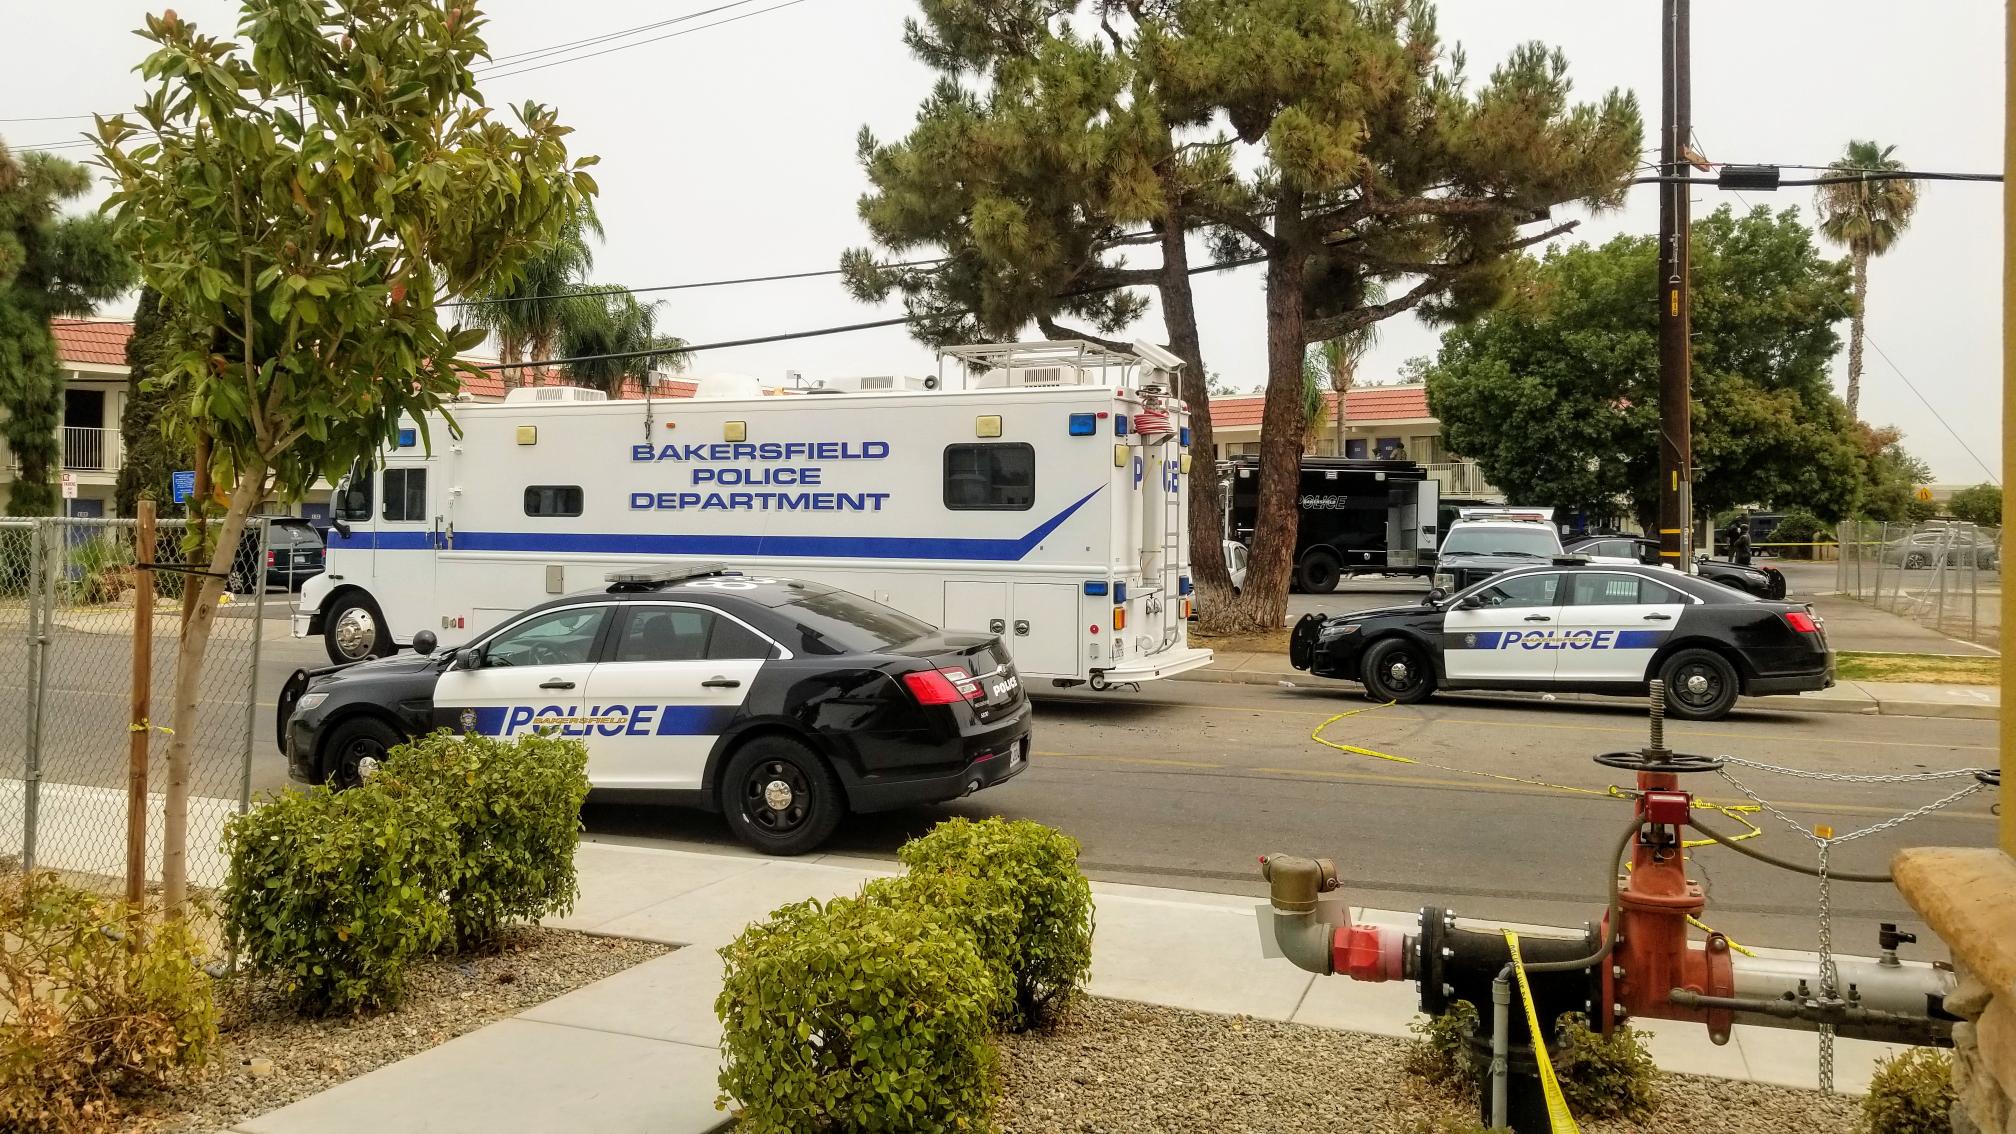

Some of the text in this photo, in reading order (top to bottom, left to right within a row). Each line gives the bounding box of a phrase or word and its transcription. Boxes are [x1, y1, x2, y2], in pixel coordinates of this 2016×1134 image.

[631, 442, 890, 461] BAKERSFIELD
[692, 467, 822, 485] POLICE
[1133, 455, 1179, 493] PCE
[630, 492, 890, 511] DEPARTMENT
[1501, 630, 1614, 650] POLICE
[993, 676, 1017, 696] POLICE
[505, 704, 658, 737] POLICE
